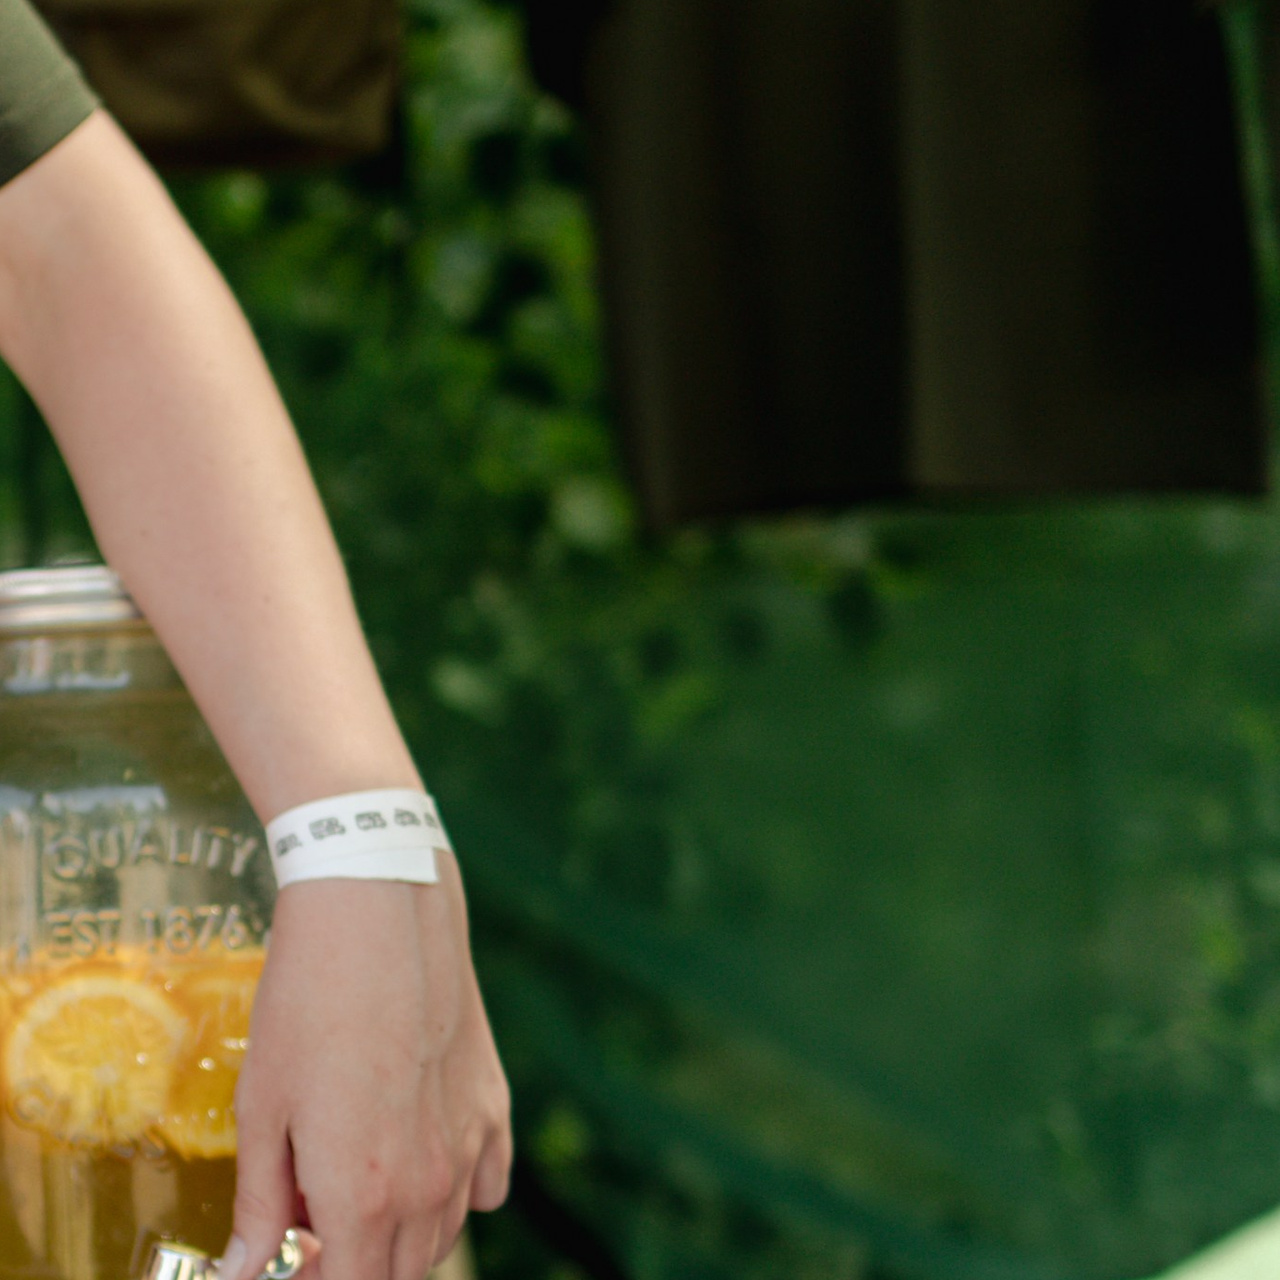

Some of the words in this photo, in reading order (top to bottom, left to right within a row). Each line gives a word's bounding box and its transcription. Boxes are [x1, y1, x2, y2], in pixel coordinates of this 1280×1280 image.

[48, 820, 260, 882] QUALITY
[48, 909, 120, 958] EST
[142, 904, 247, 954] 1876
